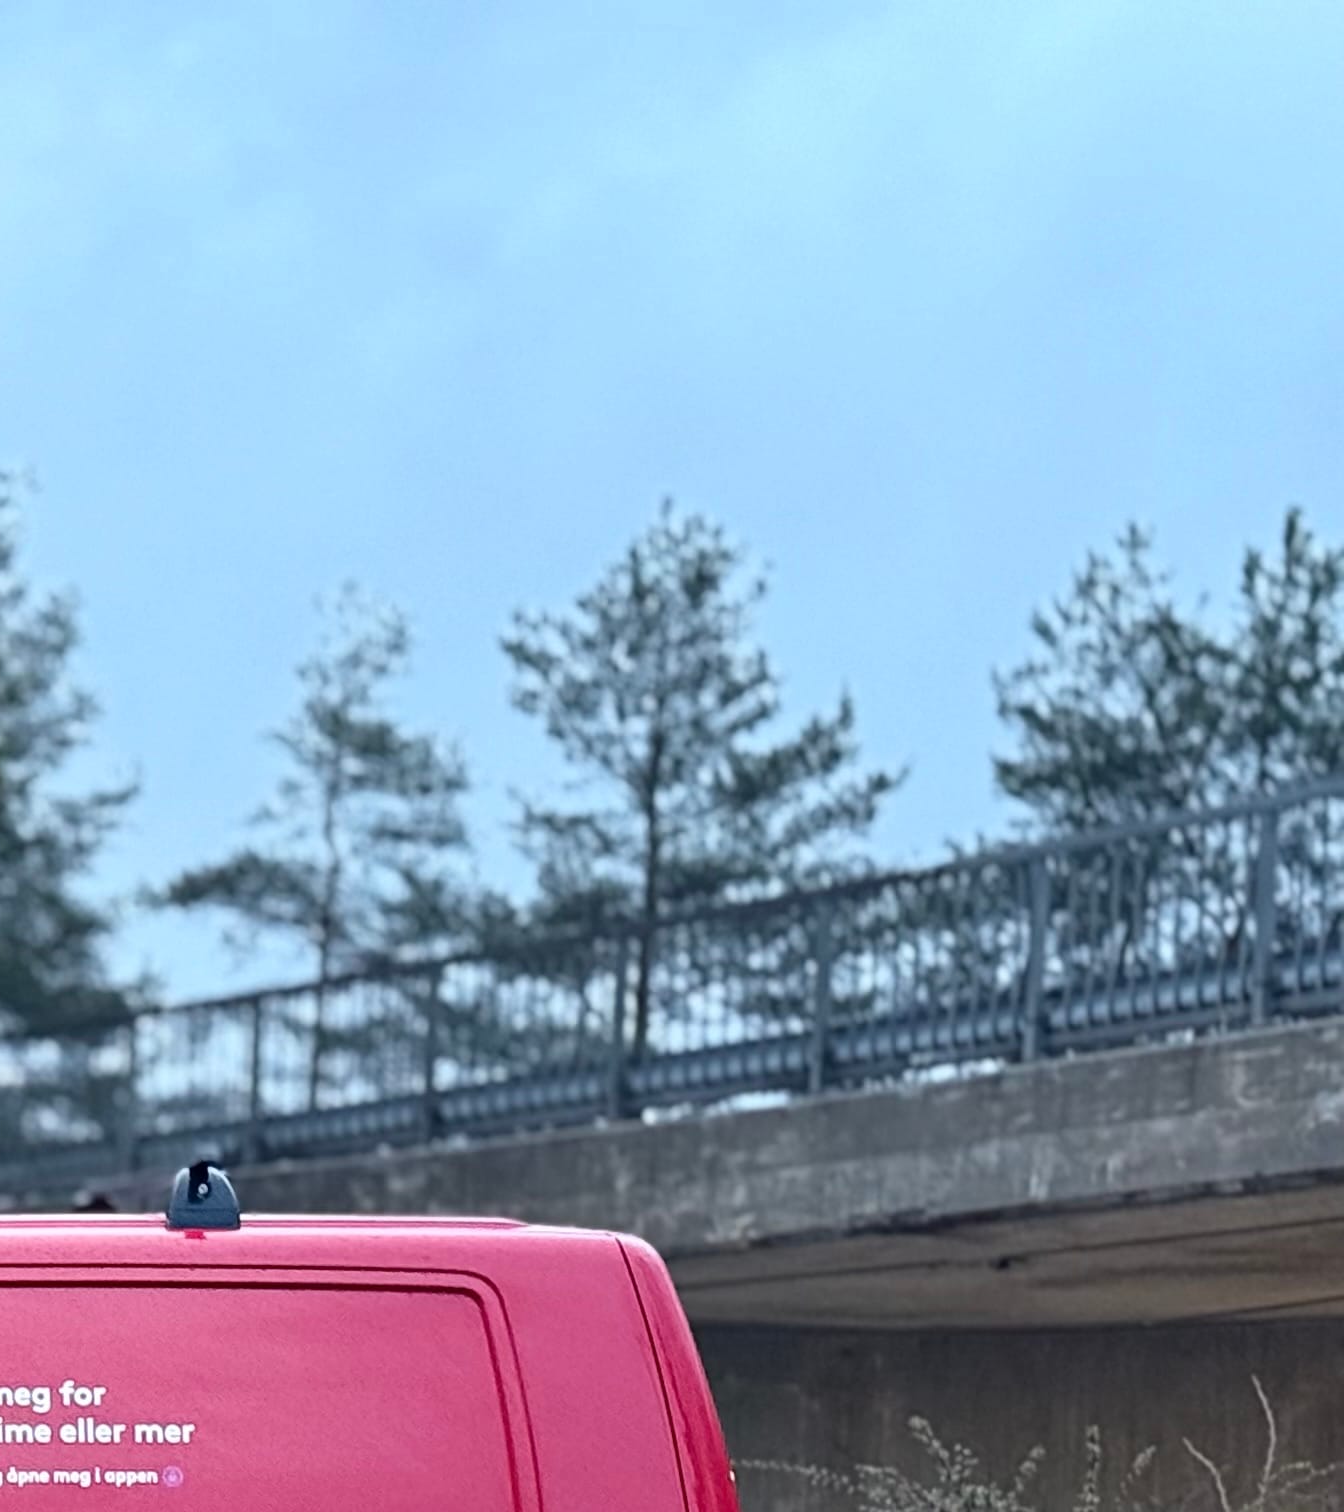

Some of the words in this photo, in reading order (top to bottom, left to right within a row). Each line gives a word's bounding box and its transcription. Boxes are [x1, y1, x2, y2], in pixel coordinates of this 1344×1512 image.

[59, 1380, 107, 1406] for
[59, 1417, 126, 1444] eller
[134, 1423, 196, 1444] mer
[6, 1466, 50, 1487] åpne
[53, 1470, 92, 1488] meg
[104, 1470, 159, 1488] appen
